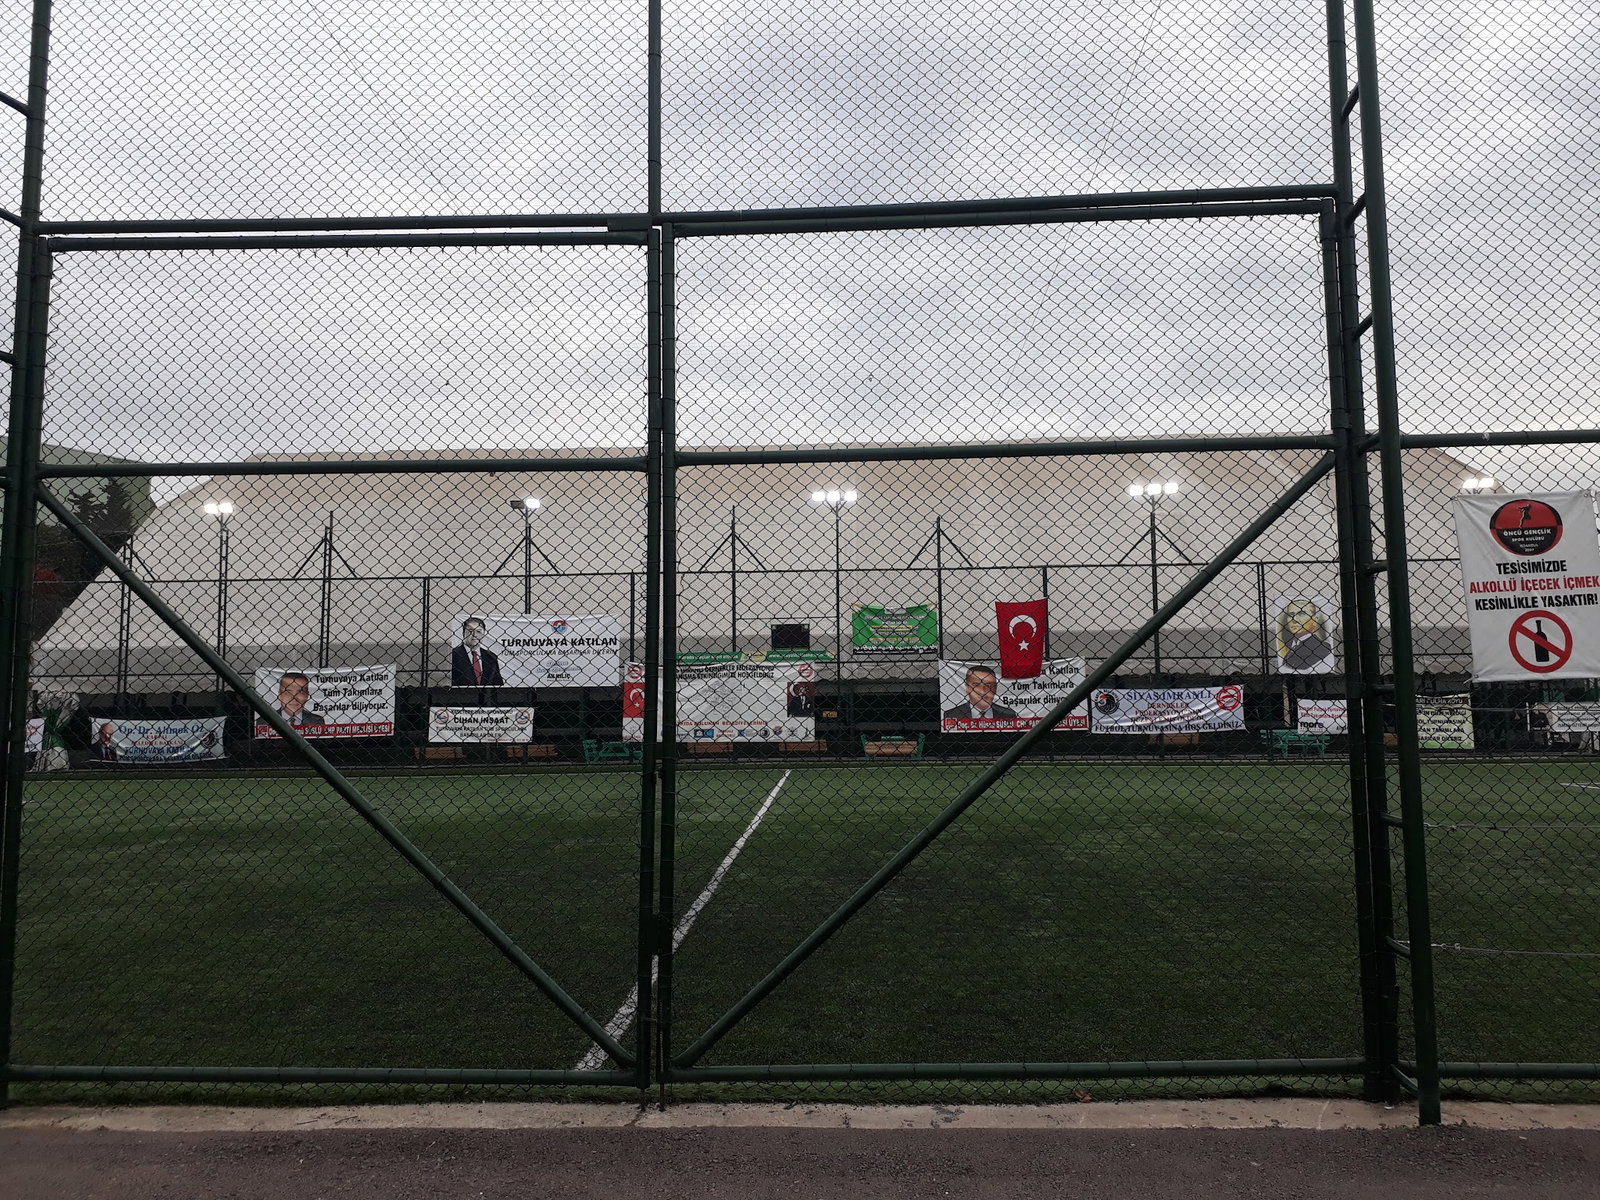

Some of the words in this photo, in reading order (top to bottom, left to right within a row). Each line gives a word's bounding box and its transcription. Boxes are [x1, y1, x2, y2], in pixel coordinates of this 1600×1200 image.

[1503, 529, 1522, 538] ÖNCÜ
[1523, 528, 1552, 537] GENÇLİK
[1496, 559, 1567, 575] TESİSİMİZDE
[1469, 577, 1517, 594] ALKOLLÜ
[1521, 575, 1560, 593] İÇECEK
[1563, 574, 1600, 591] İÇMEK
[1475, 595, 1539, 611] KESİNLİKLE
[1540, 593, 1599, 609] YASAKTIR!
[500, 638, 568, 647] TURNUVAYA
[570, 637, 618, 646] KATILAN
[1049, 666, 1079, 675] Katılan
[359, 672, 389, 682] Katılan
[1011, 681, 1030, 691] Tüm
[1033, 680, 1074, 690] Takımlara
[323, 687, 340, 697] Tüm
[343, 686, 383, 696] Takımlara
[1002, 695, 1041, 706] Başarılar
[480, 715, 510, 724] İNŞAAT
[138, 725, 153, 734] Dr.
[1095, 724, 1126, 732] FUTBOL
[1126, 723, 1184, 731] TURNUVASINA
